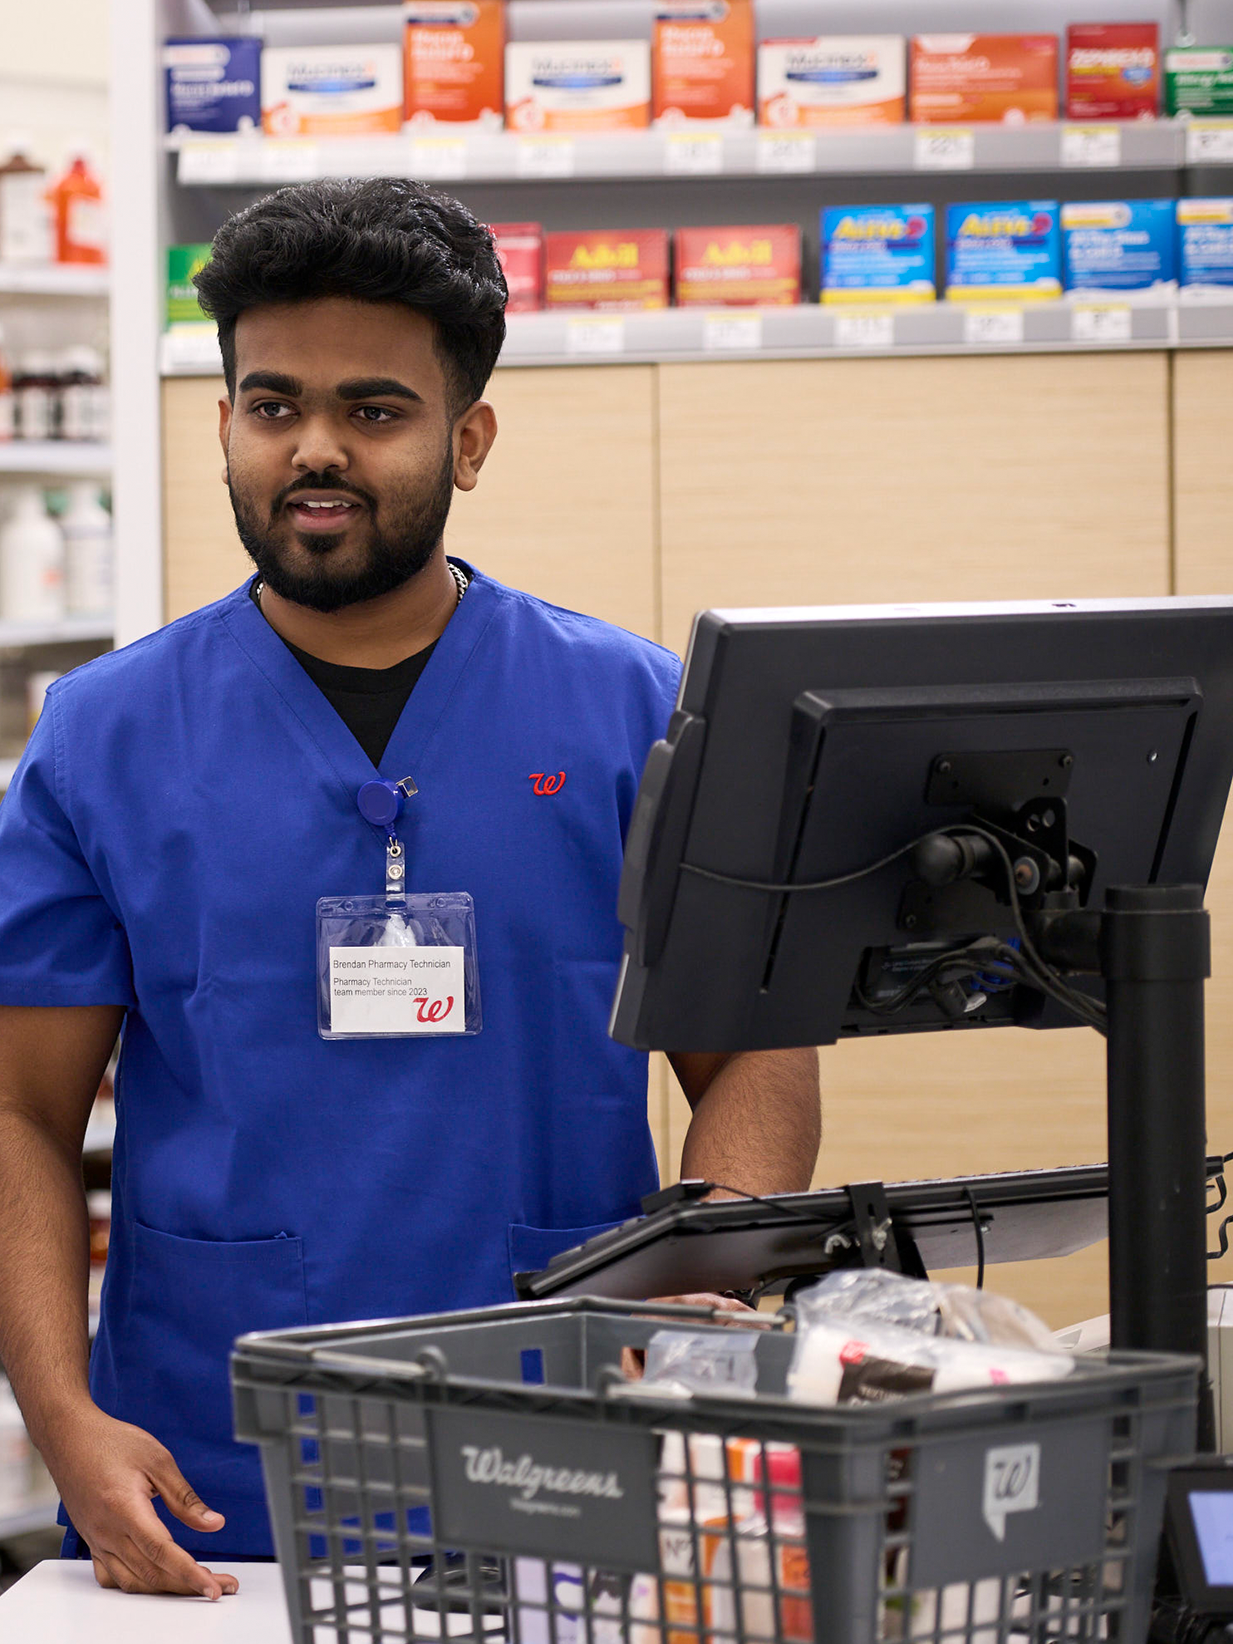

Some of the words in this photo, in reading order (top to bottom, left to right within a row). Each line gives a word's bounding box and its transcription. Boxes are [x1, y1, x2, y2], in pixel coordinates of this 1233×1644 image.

[333, 960, 366, 969] Brendan
[368, 960, 408, 971] Pharmacy
[409, 959, 451, 969] Technician
[333, 977, 371, 988] Pharmacy
[373, 977, 413, 986] Technician
[354, 987, 386, 996] member
[387, 987, 407, 996] since
[408, 987, 428, 996] 2023
[460, 1445, 625, 1499] Walgreens
